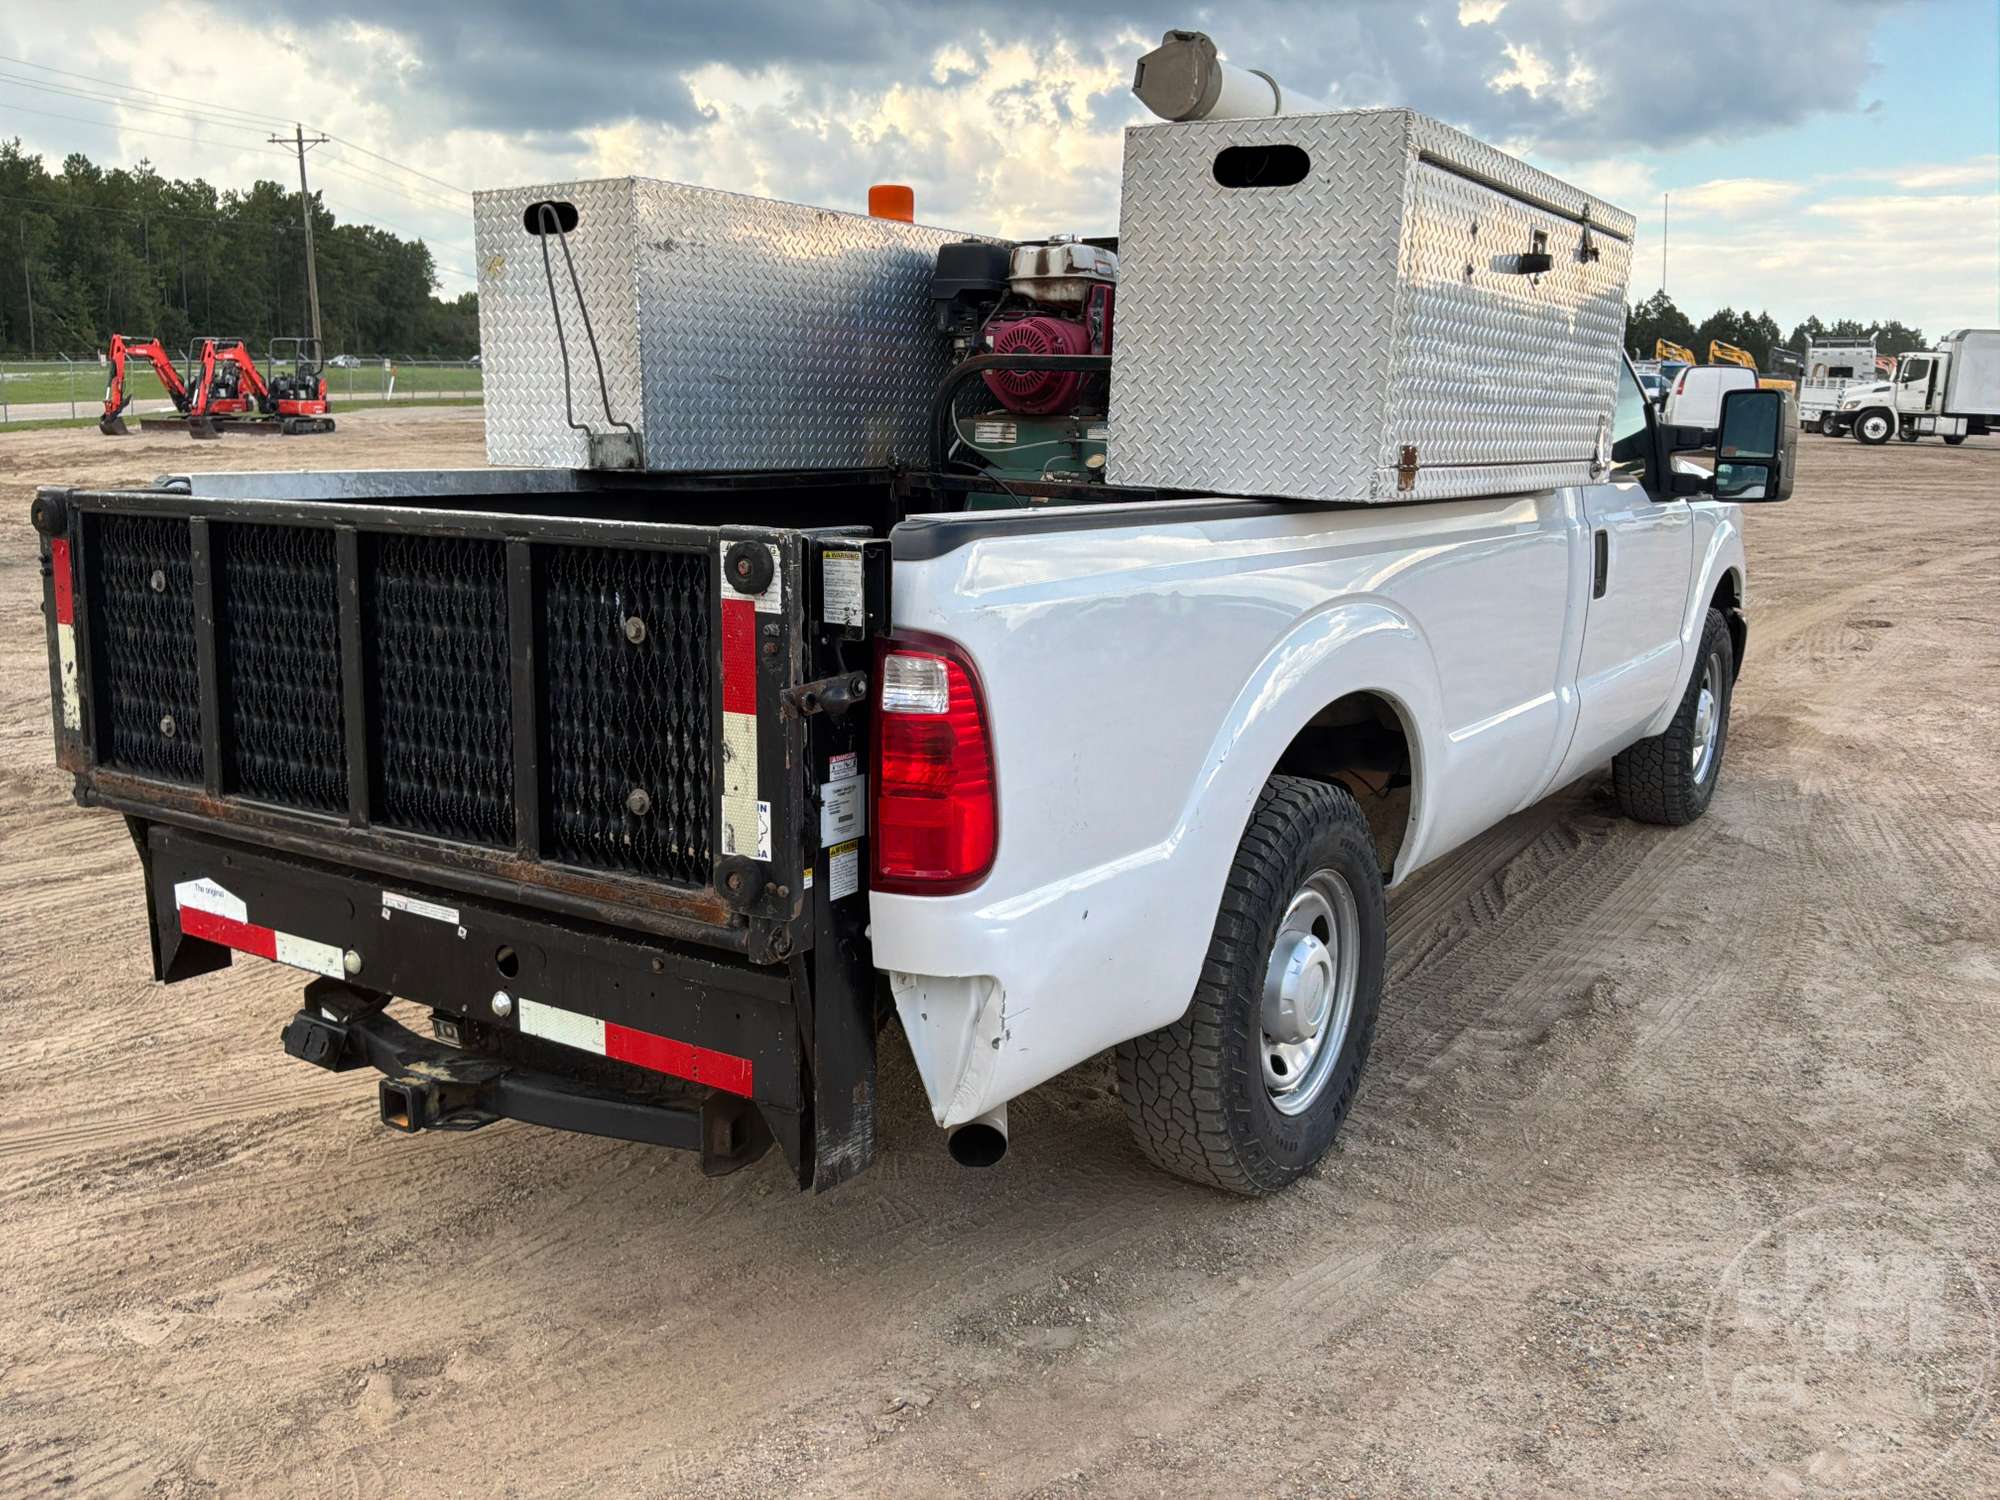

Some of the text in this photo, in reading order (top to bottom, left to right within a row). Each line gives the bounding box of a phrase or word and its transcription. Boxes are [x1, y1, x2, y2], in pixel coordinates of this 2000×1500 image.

[831, 552, 860, 560] WARNING
[195, 884, 224, 898] The original
